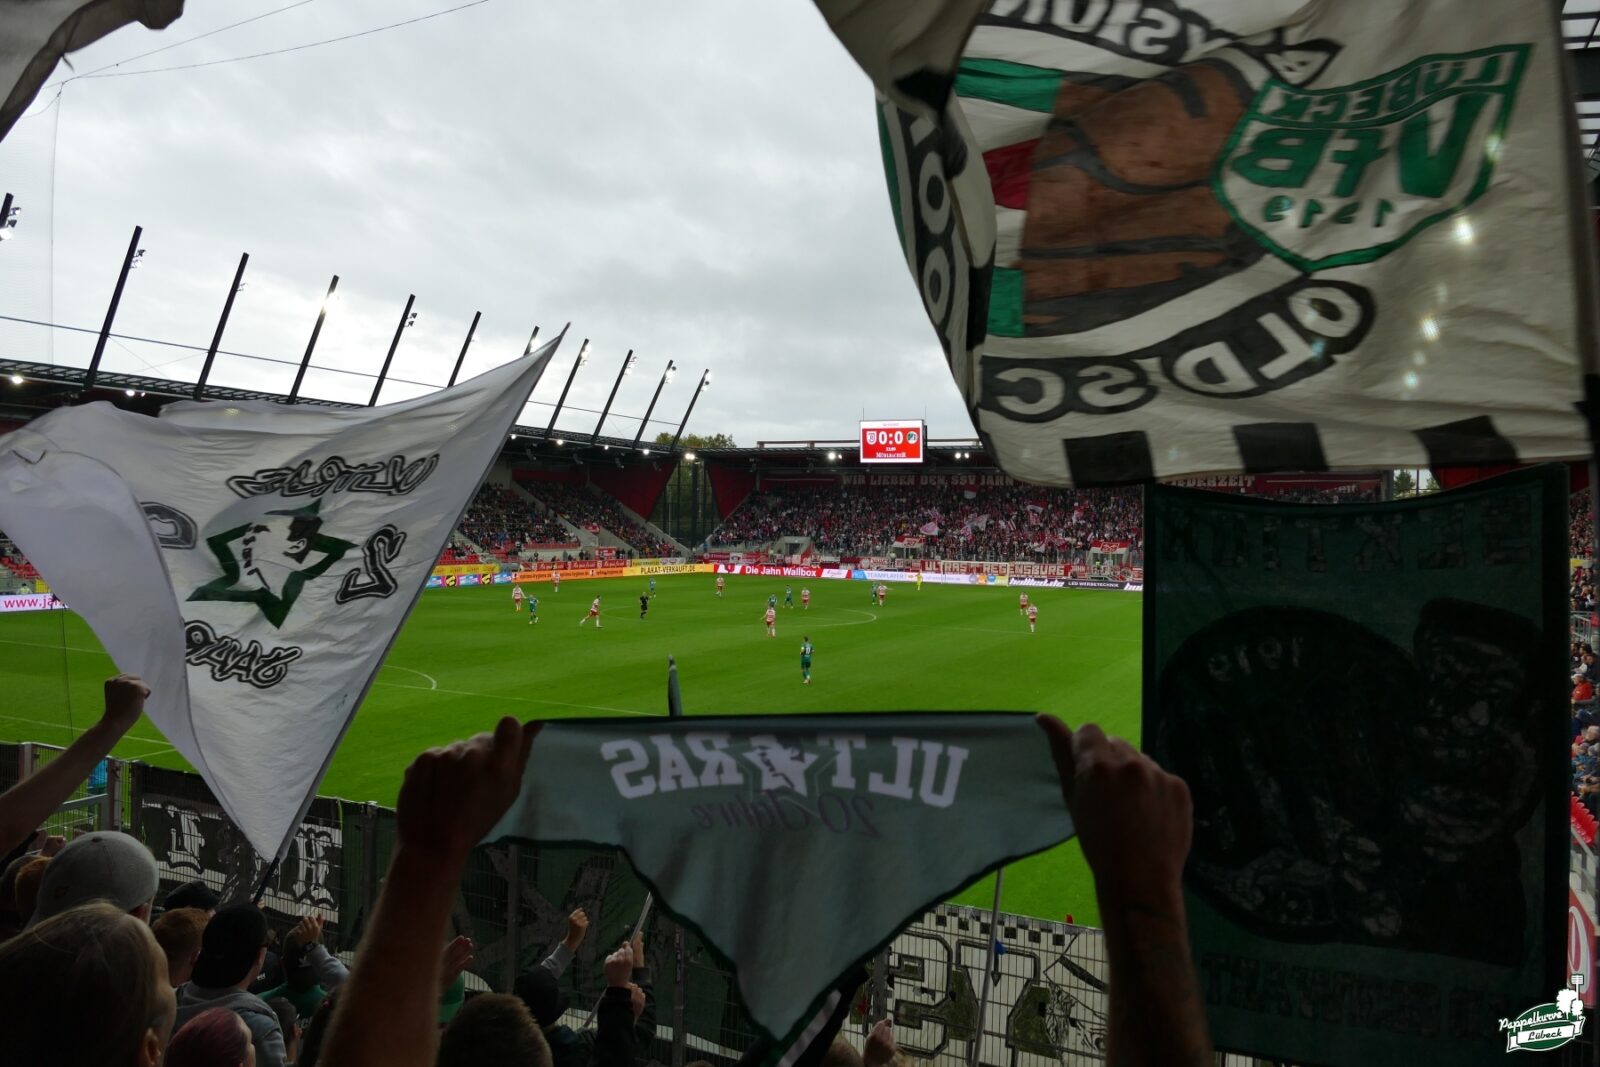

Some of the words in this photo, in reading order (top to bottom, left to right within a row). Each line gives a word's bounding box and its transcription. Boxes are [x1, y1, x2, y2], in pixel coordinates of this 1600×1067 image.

[878, 430, 904, 445] 0:0
[870, 474, 916, 486] LIEBEN
[951, 474, 977, 486] SSV
[745, 566, 760, 574] Die
[760, 566, 782, 575] Jahn
[782, 566, 817, 577] Wallbox
[925, 560, 967, 573] ULTRAS
[983, 562, 1065, 577] REGENSBURG
